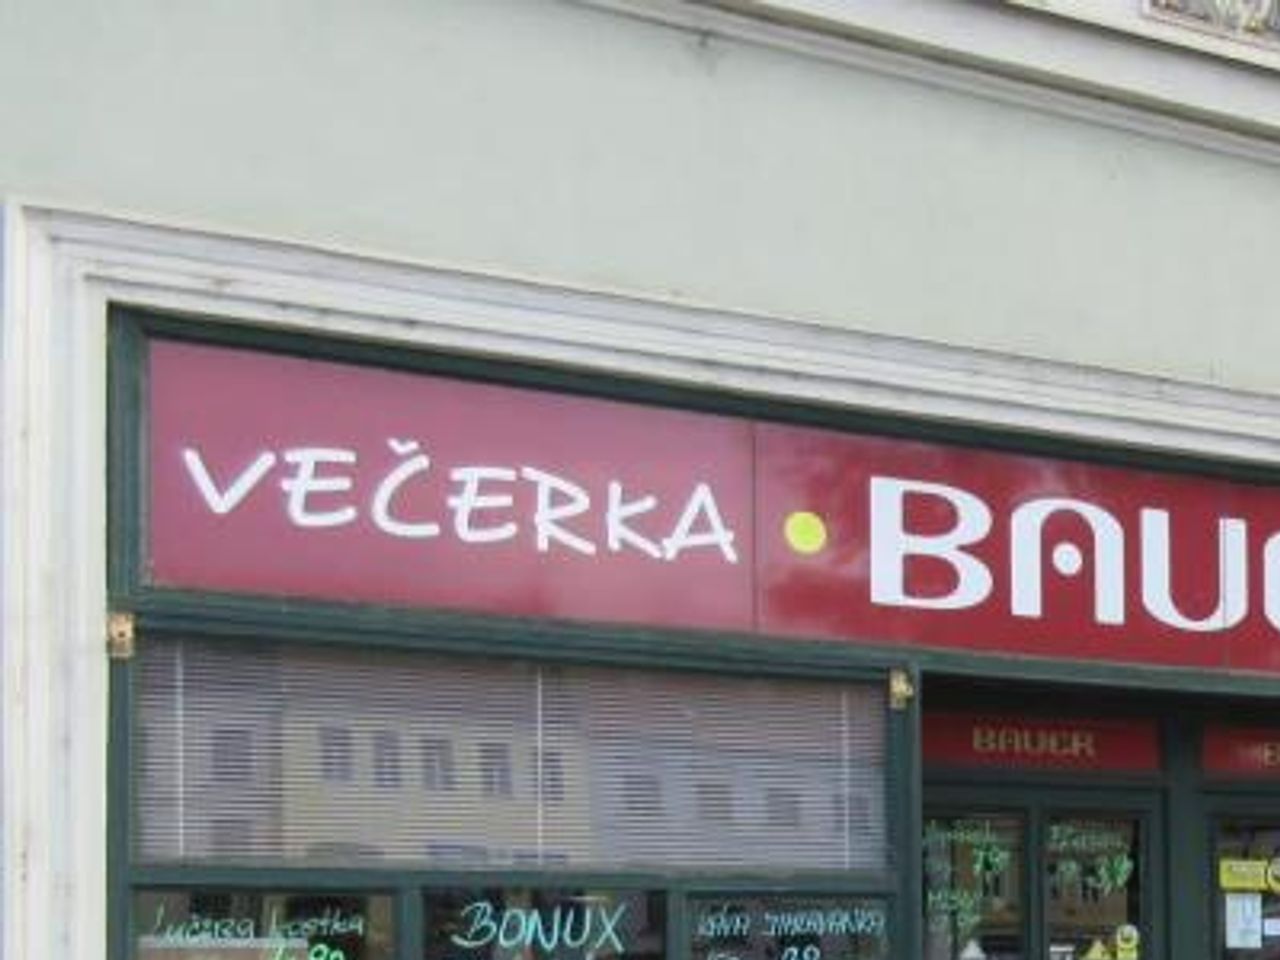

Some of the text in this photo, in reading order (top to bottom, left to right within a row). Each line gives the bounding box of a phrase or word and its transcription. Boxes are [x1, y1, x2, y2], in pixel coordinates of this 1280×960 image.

[182, 437, 738, 563] VEČERKA
[972, 726, 1096, 757] BAUER
[450, 901, 626, 953] BONUX
